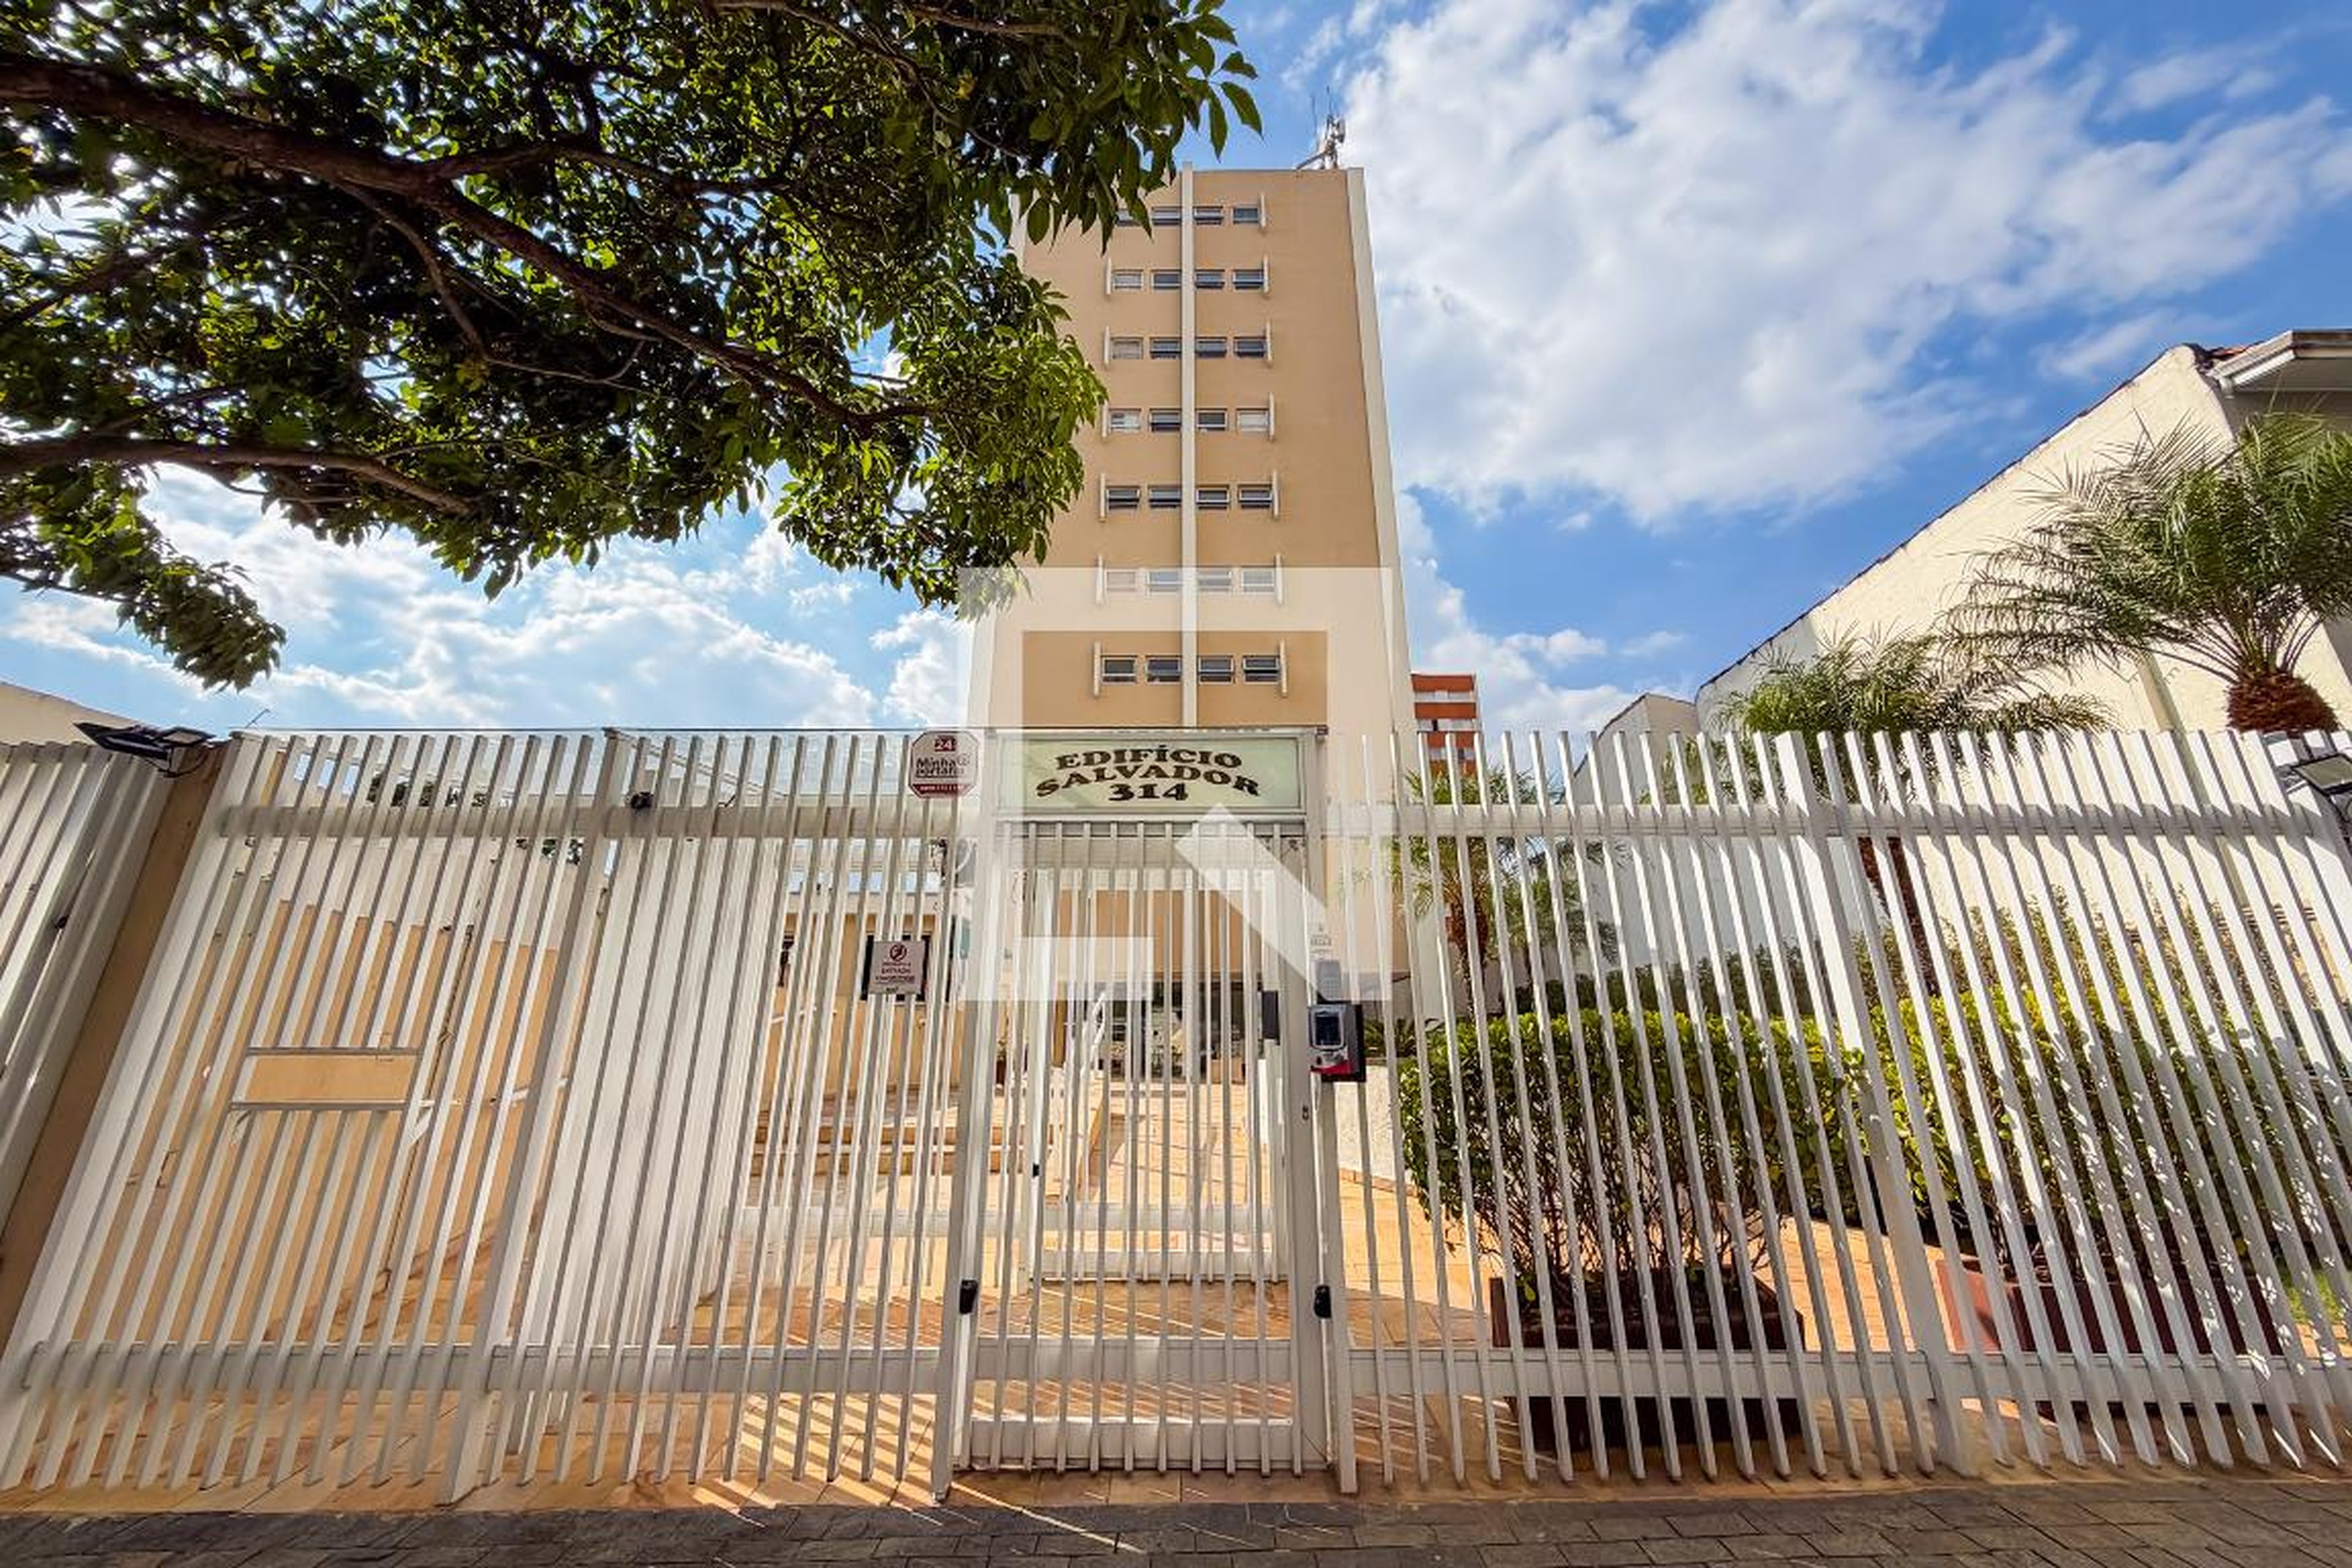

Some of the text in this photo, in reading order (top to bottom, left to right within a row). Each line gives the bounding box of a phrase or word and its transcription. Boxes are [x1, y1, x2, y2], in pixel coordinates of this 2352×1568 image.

[1055, 744, 1243, 770] EDIFÍCIO
[1036, 764, 1259, 797] SALVADOR
[1108, 782, 1189, 801] 314
